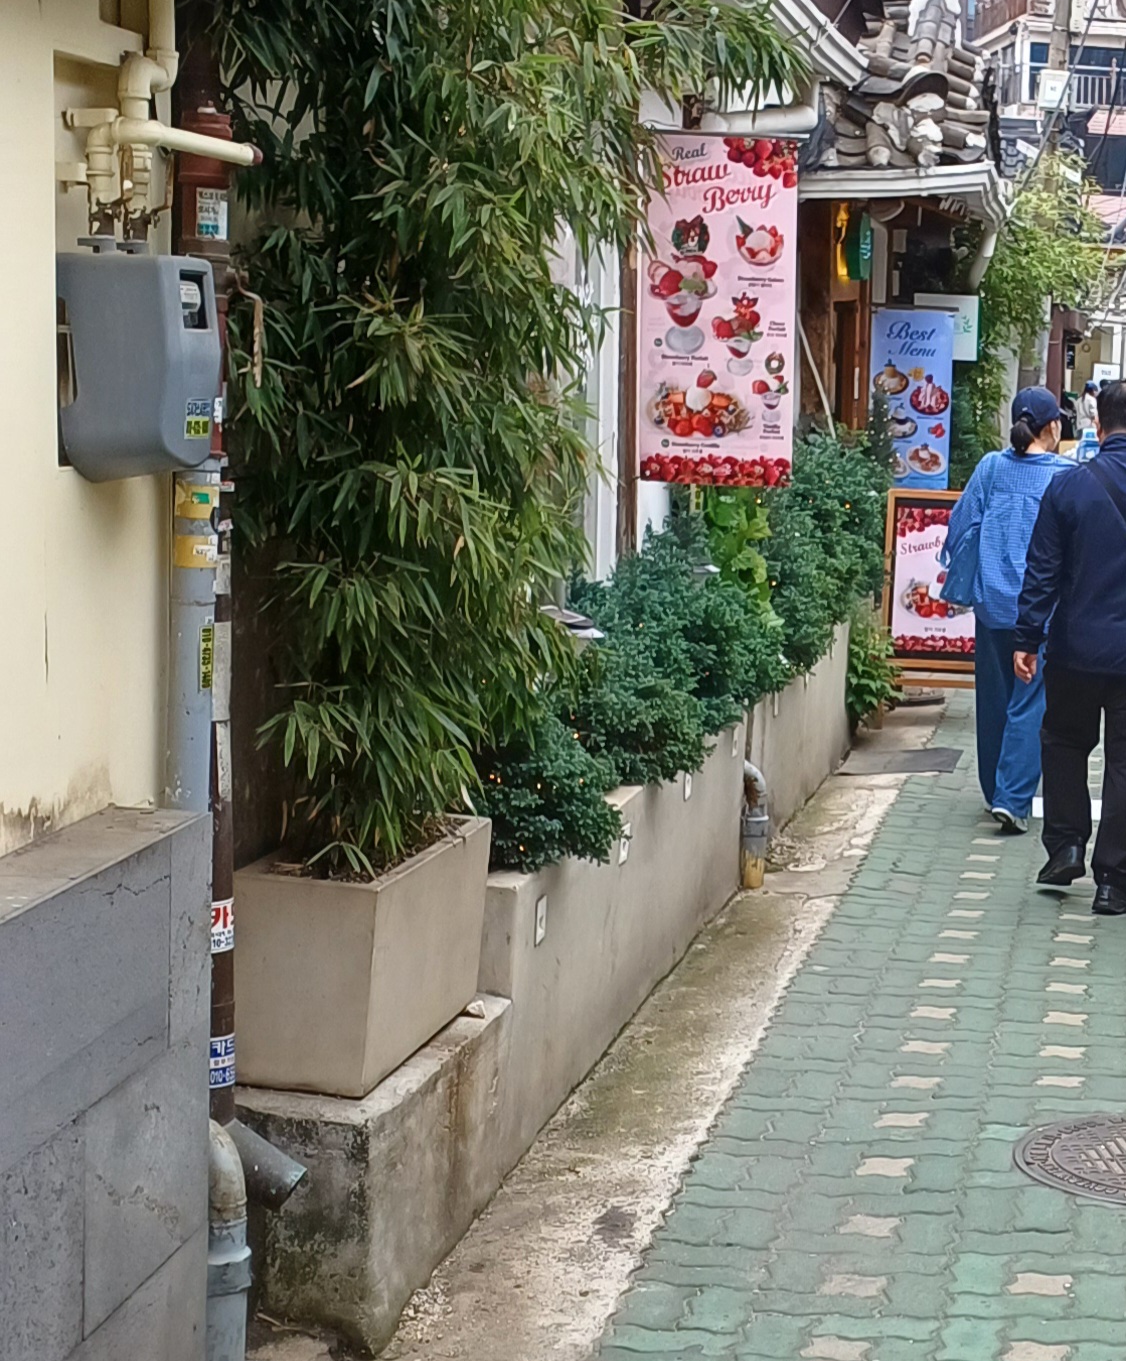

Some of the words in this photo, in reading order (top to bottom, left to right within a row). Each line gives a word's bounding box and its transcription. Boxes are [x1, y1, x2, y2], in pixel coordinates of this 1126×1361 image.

[672, 142, 708, 160] Real
[662, 163, 732, 189] Straw
[702, 184, 777, 213] Berry
[886, 320, 936, 341] Best
[887, 341, 936, 358] Menu
[900, 536, 945, 555] Strawb
